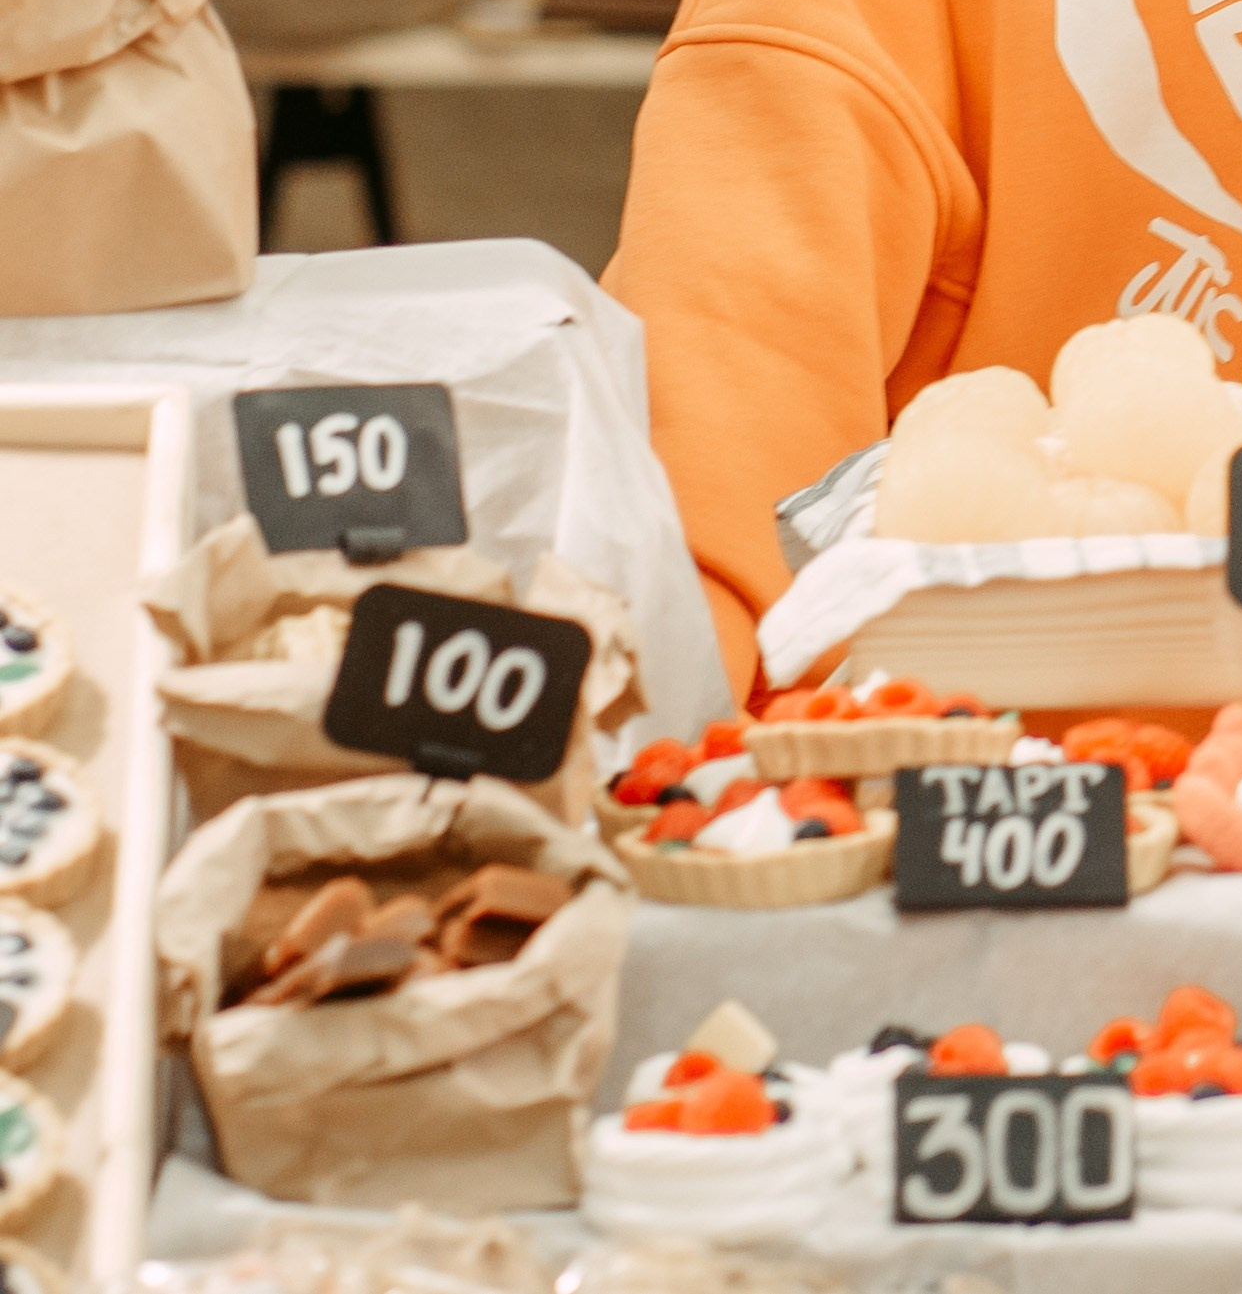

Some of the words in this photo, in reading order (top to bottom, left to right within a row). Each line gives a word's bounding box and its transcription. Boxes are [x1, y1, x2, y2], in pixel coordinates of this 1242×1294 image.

[275, 412, 408, 499] 150
[384, 619, 548, 731] 100
[921, 763, 1107, 814] ТАРТ
[939, 813, 1087, 891] 400
[903, 1084, 1133, 1219] 300
